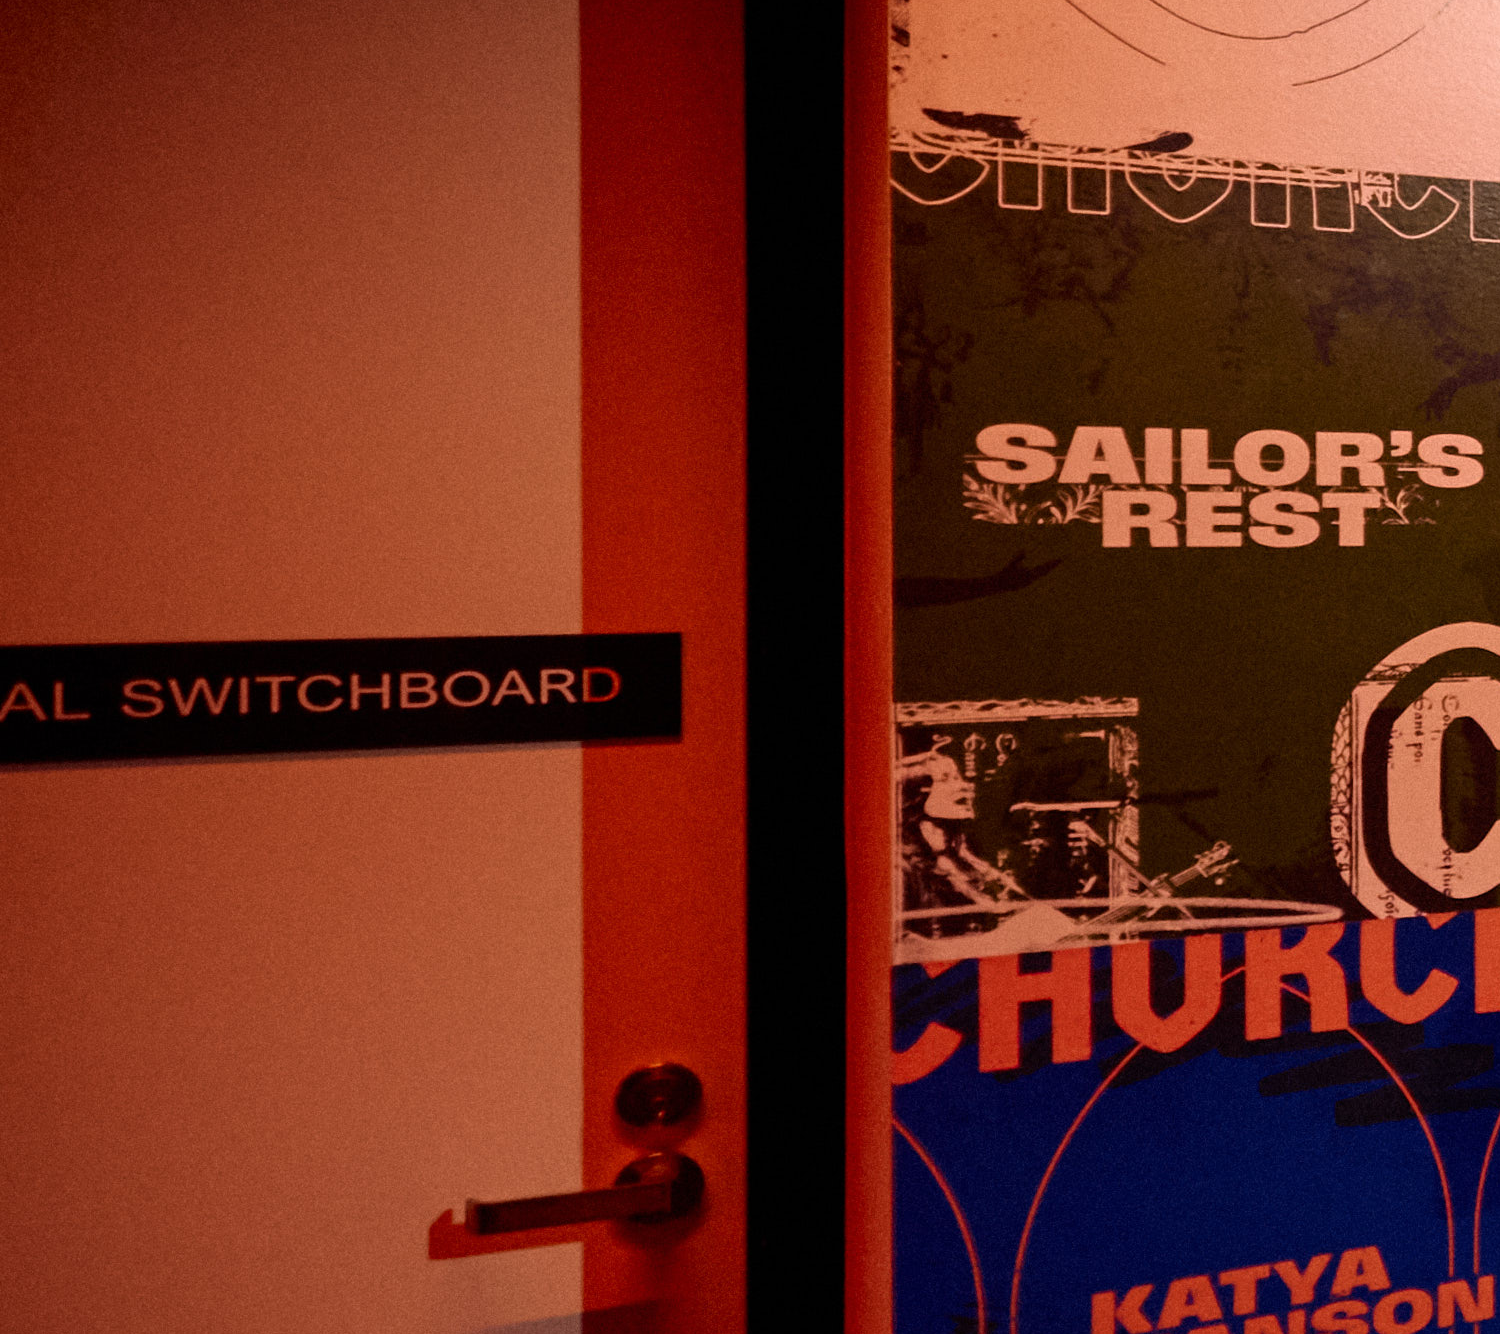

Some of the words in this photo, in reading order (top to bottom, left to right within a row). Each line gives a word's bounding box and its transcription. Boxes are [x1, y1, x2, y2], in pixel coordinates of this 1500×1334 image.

[973, 422, 1484, 489] SAILOR'S
[1101, 490, 1383, 549] REST
[0, 681, 90, 721] AL
[120, 667, 622, 720] SWITCHBOARD
